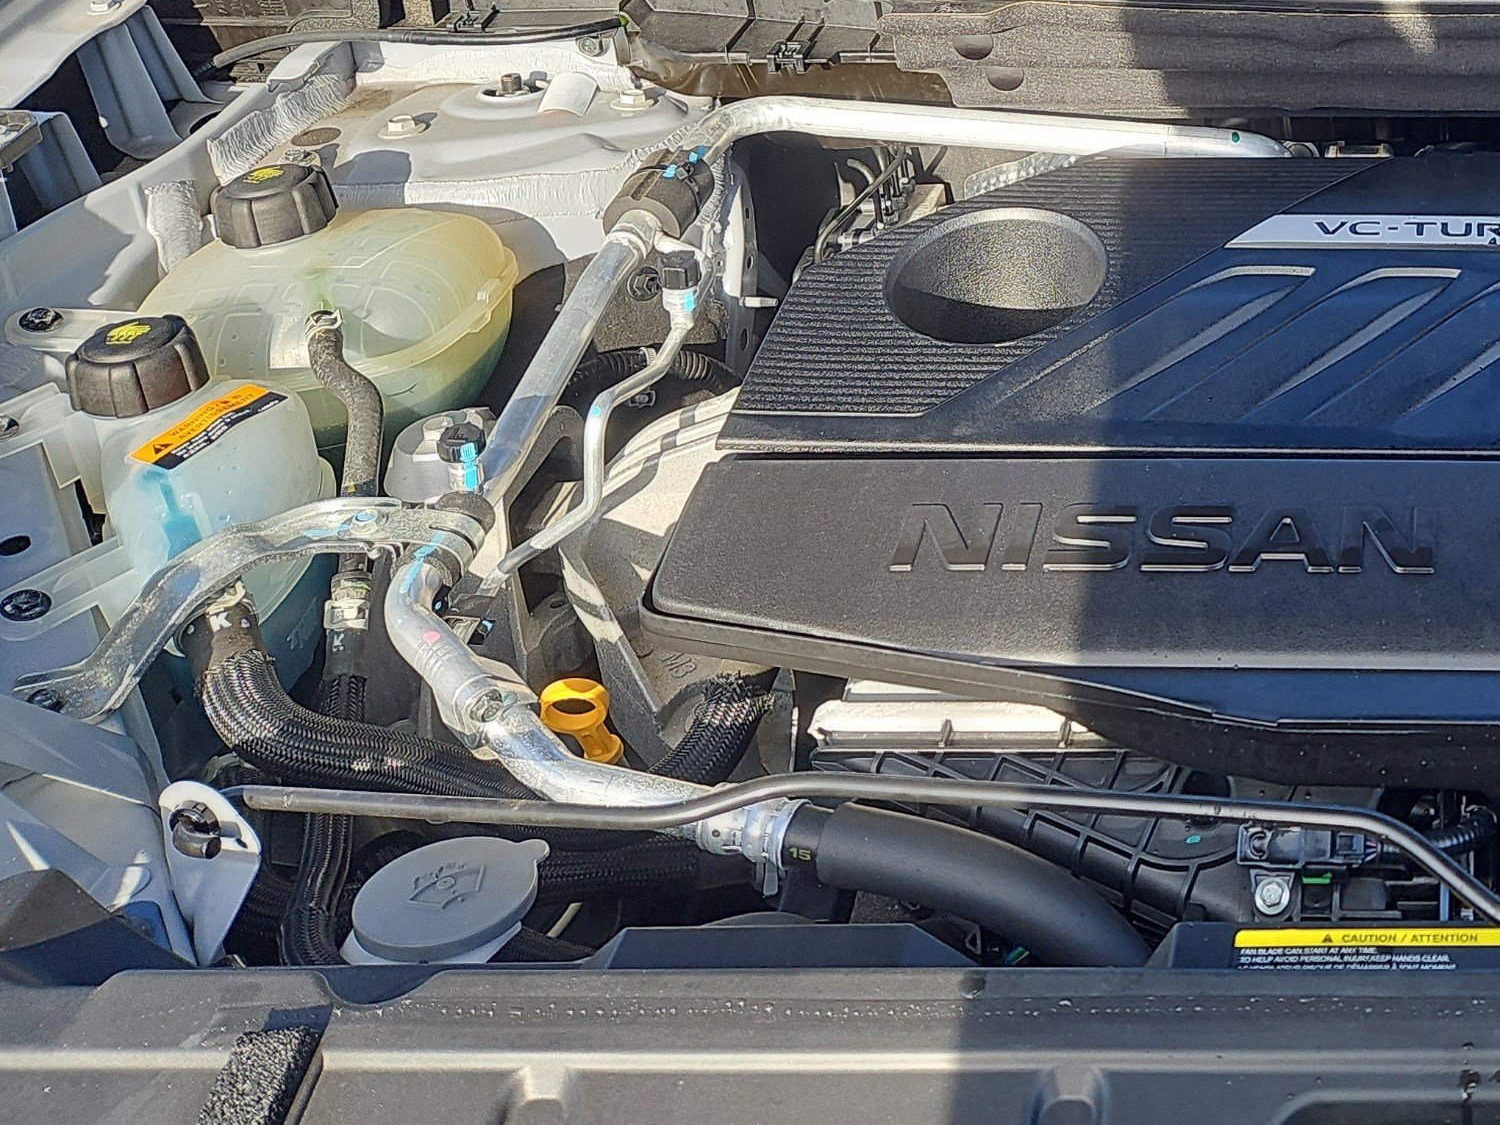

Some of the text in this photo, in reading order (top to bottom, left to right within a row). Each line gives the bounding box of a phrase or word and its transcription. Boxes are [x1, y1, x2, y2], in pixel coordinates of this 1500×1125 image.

[889, 503, 1436, 574] NISSAN
[209, 611, 232, 632] K
[789, 846, 811, 861] 15
[1341, 934, 1397, 943] CAUTION
[1410, 933, 1478, 943] ATTENTION
[1240, 948, 1257, 956] FAN
[1273, 955, 1299, 963] AVOID
[1392, 954, 1420, 962] HANDS
